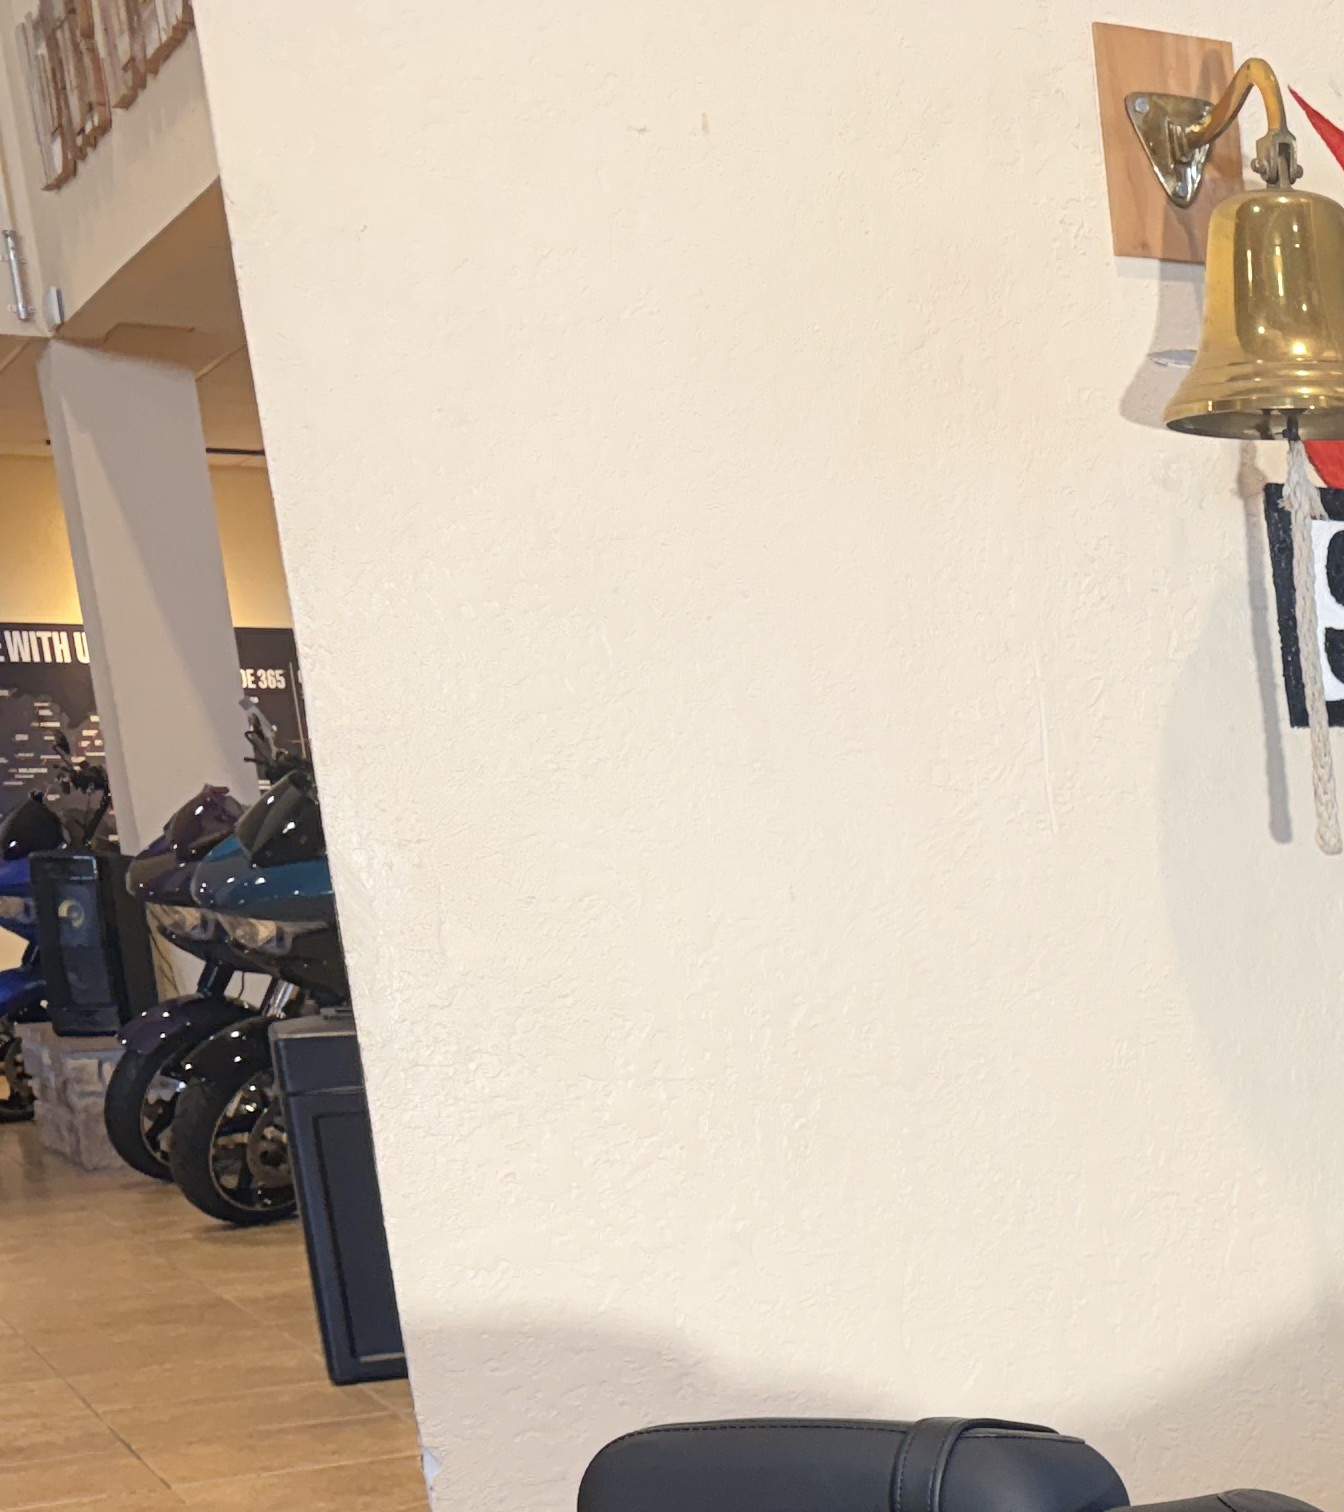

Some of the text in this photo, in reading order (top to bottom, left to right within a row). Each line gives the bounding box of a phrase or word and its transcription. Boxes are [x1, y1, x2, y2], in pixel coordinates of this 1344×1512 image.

[4, 629, 72, 664] WITH
[72, 631, 91, 664] U
[257, 668, 286, 690] 365
